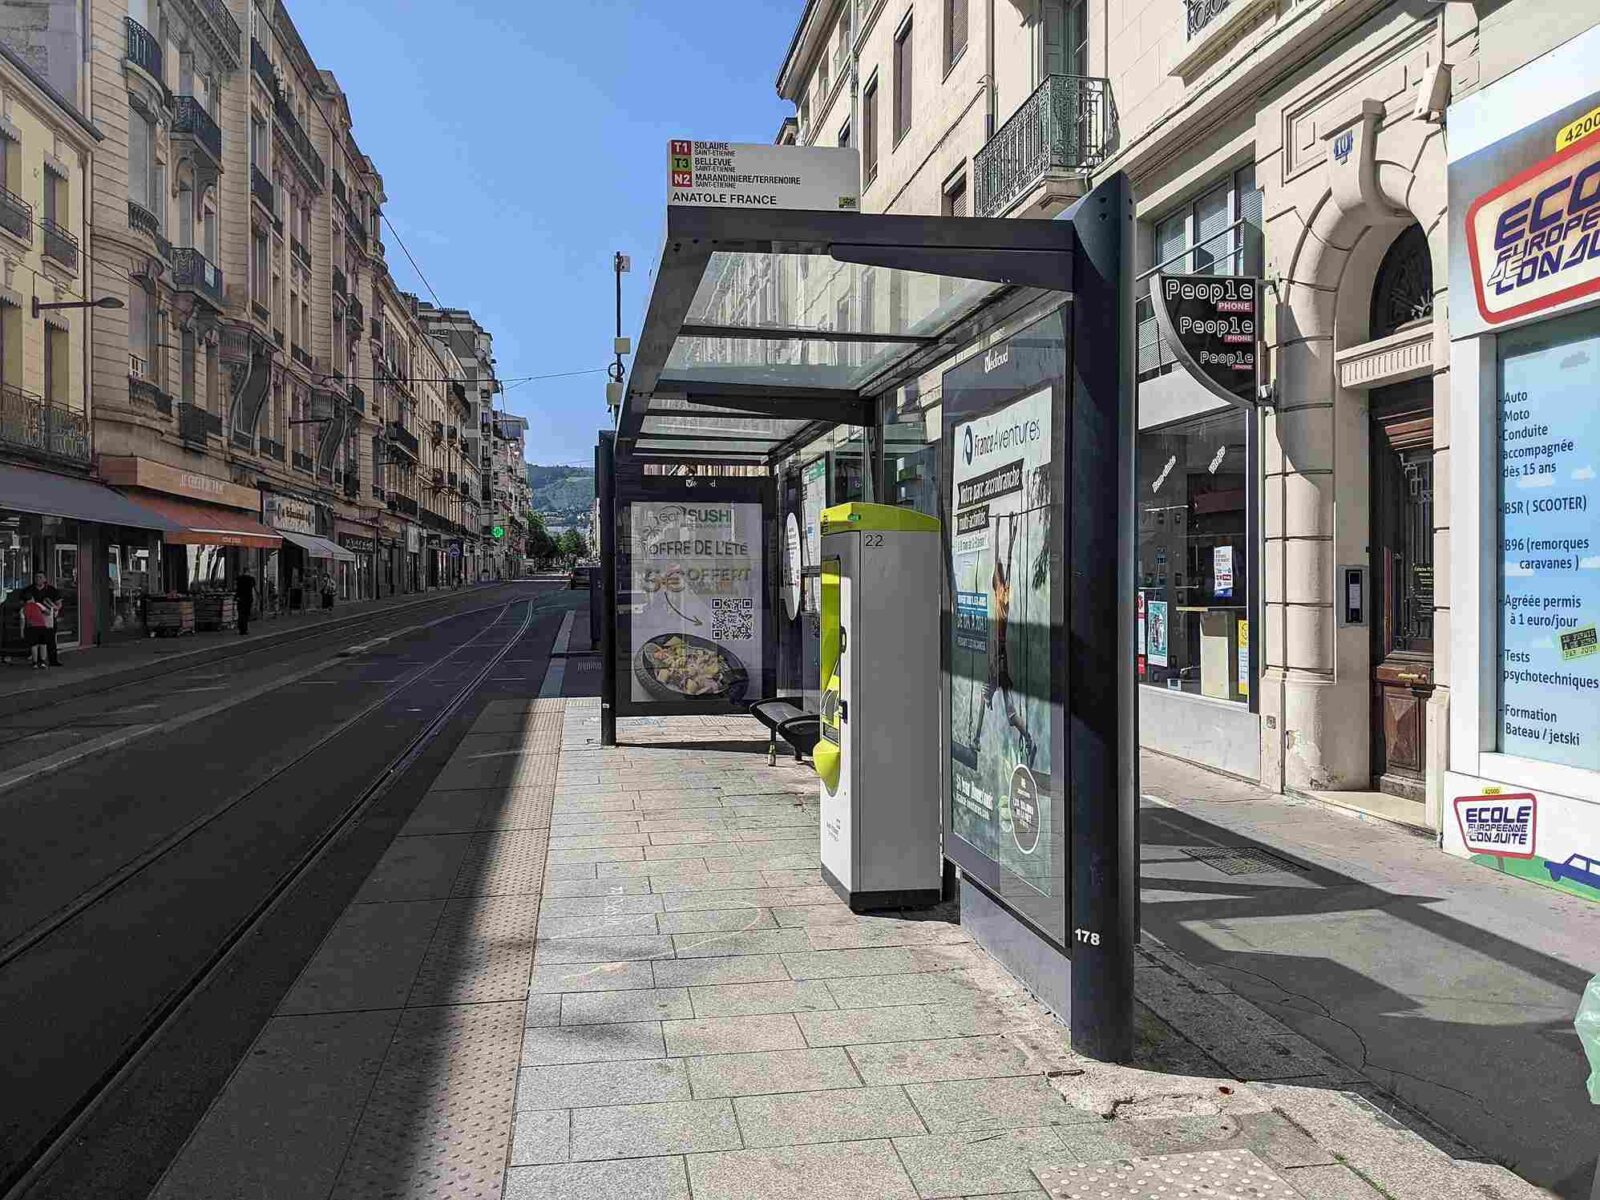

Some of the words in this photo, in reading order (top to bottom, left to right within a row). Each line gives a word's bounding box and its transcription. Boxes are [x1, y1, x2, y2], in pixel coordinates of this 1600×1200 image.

[675, 141, 689, 153] T1
[694, 141, 729, 150] SOLAURE
[674, 157, 689, 168] T3
[694, 157, 732, 166] BELLEVUE
[673, 173, 691, 185] N2
[672, 192, 727, 204] ANATOLE
[730, 193, 777, 205] FRANCE
[1165, 279, 1254, 304] People
[1218, 301, 1252, 310] PHONE
[1179, 316, 1254, 338] People
[1200, 350, 1254, 367] People
[1504, 391, 1528, 405] Auto
[1504, 409, 1530, 422] Moto
[1502, 424, 1549, 441] Conduite
[1502, 439, 1574, 460] accompagnée
[1502, 466, 1520, 478] dès
[1523, 463, 1536, 476] 15
[1538, 463, 1557, 475] ans
[1504, 502, 1524, 515] BSR
[1532, 495, 1587, 513] SCOOTER)
[687, 509, 731, 522] SUSHI
[649, 540, 691, 556] OFFRE
[694, 540, 712, 556] DE
[865, 534, 884, 548] 22
[1504, 538, 1524, 551] B96
[1527, 537, 1590, 553] (remorques
[1519, 558, 1572, 570] caravanes
[1504, 594, 1541, 610] Agréée
[1543, 595, 1582, 611] permis
[1510, 613, 1516, 625] à
[1519, 613, 1524, 625] 1
[1527, 614, 1578, 630] euro/jour
[1505, 649, 1530, 663] Tests
[1503, 669, 1600, 691] psychotechniques
[1505, 704, 1557, 723] Formation
[1505, 722, 1540, 740] Bateau
[1549, 729, 1580, 746] jetski
[1465, 806, 1532, 824] ECOLE
[1468, 823, 1528, 833] EUROPEENNE
[1469, 832, 1528, 845] CONDUITE
[1073, 928, 1101, 946] 178
